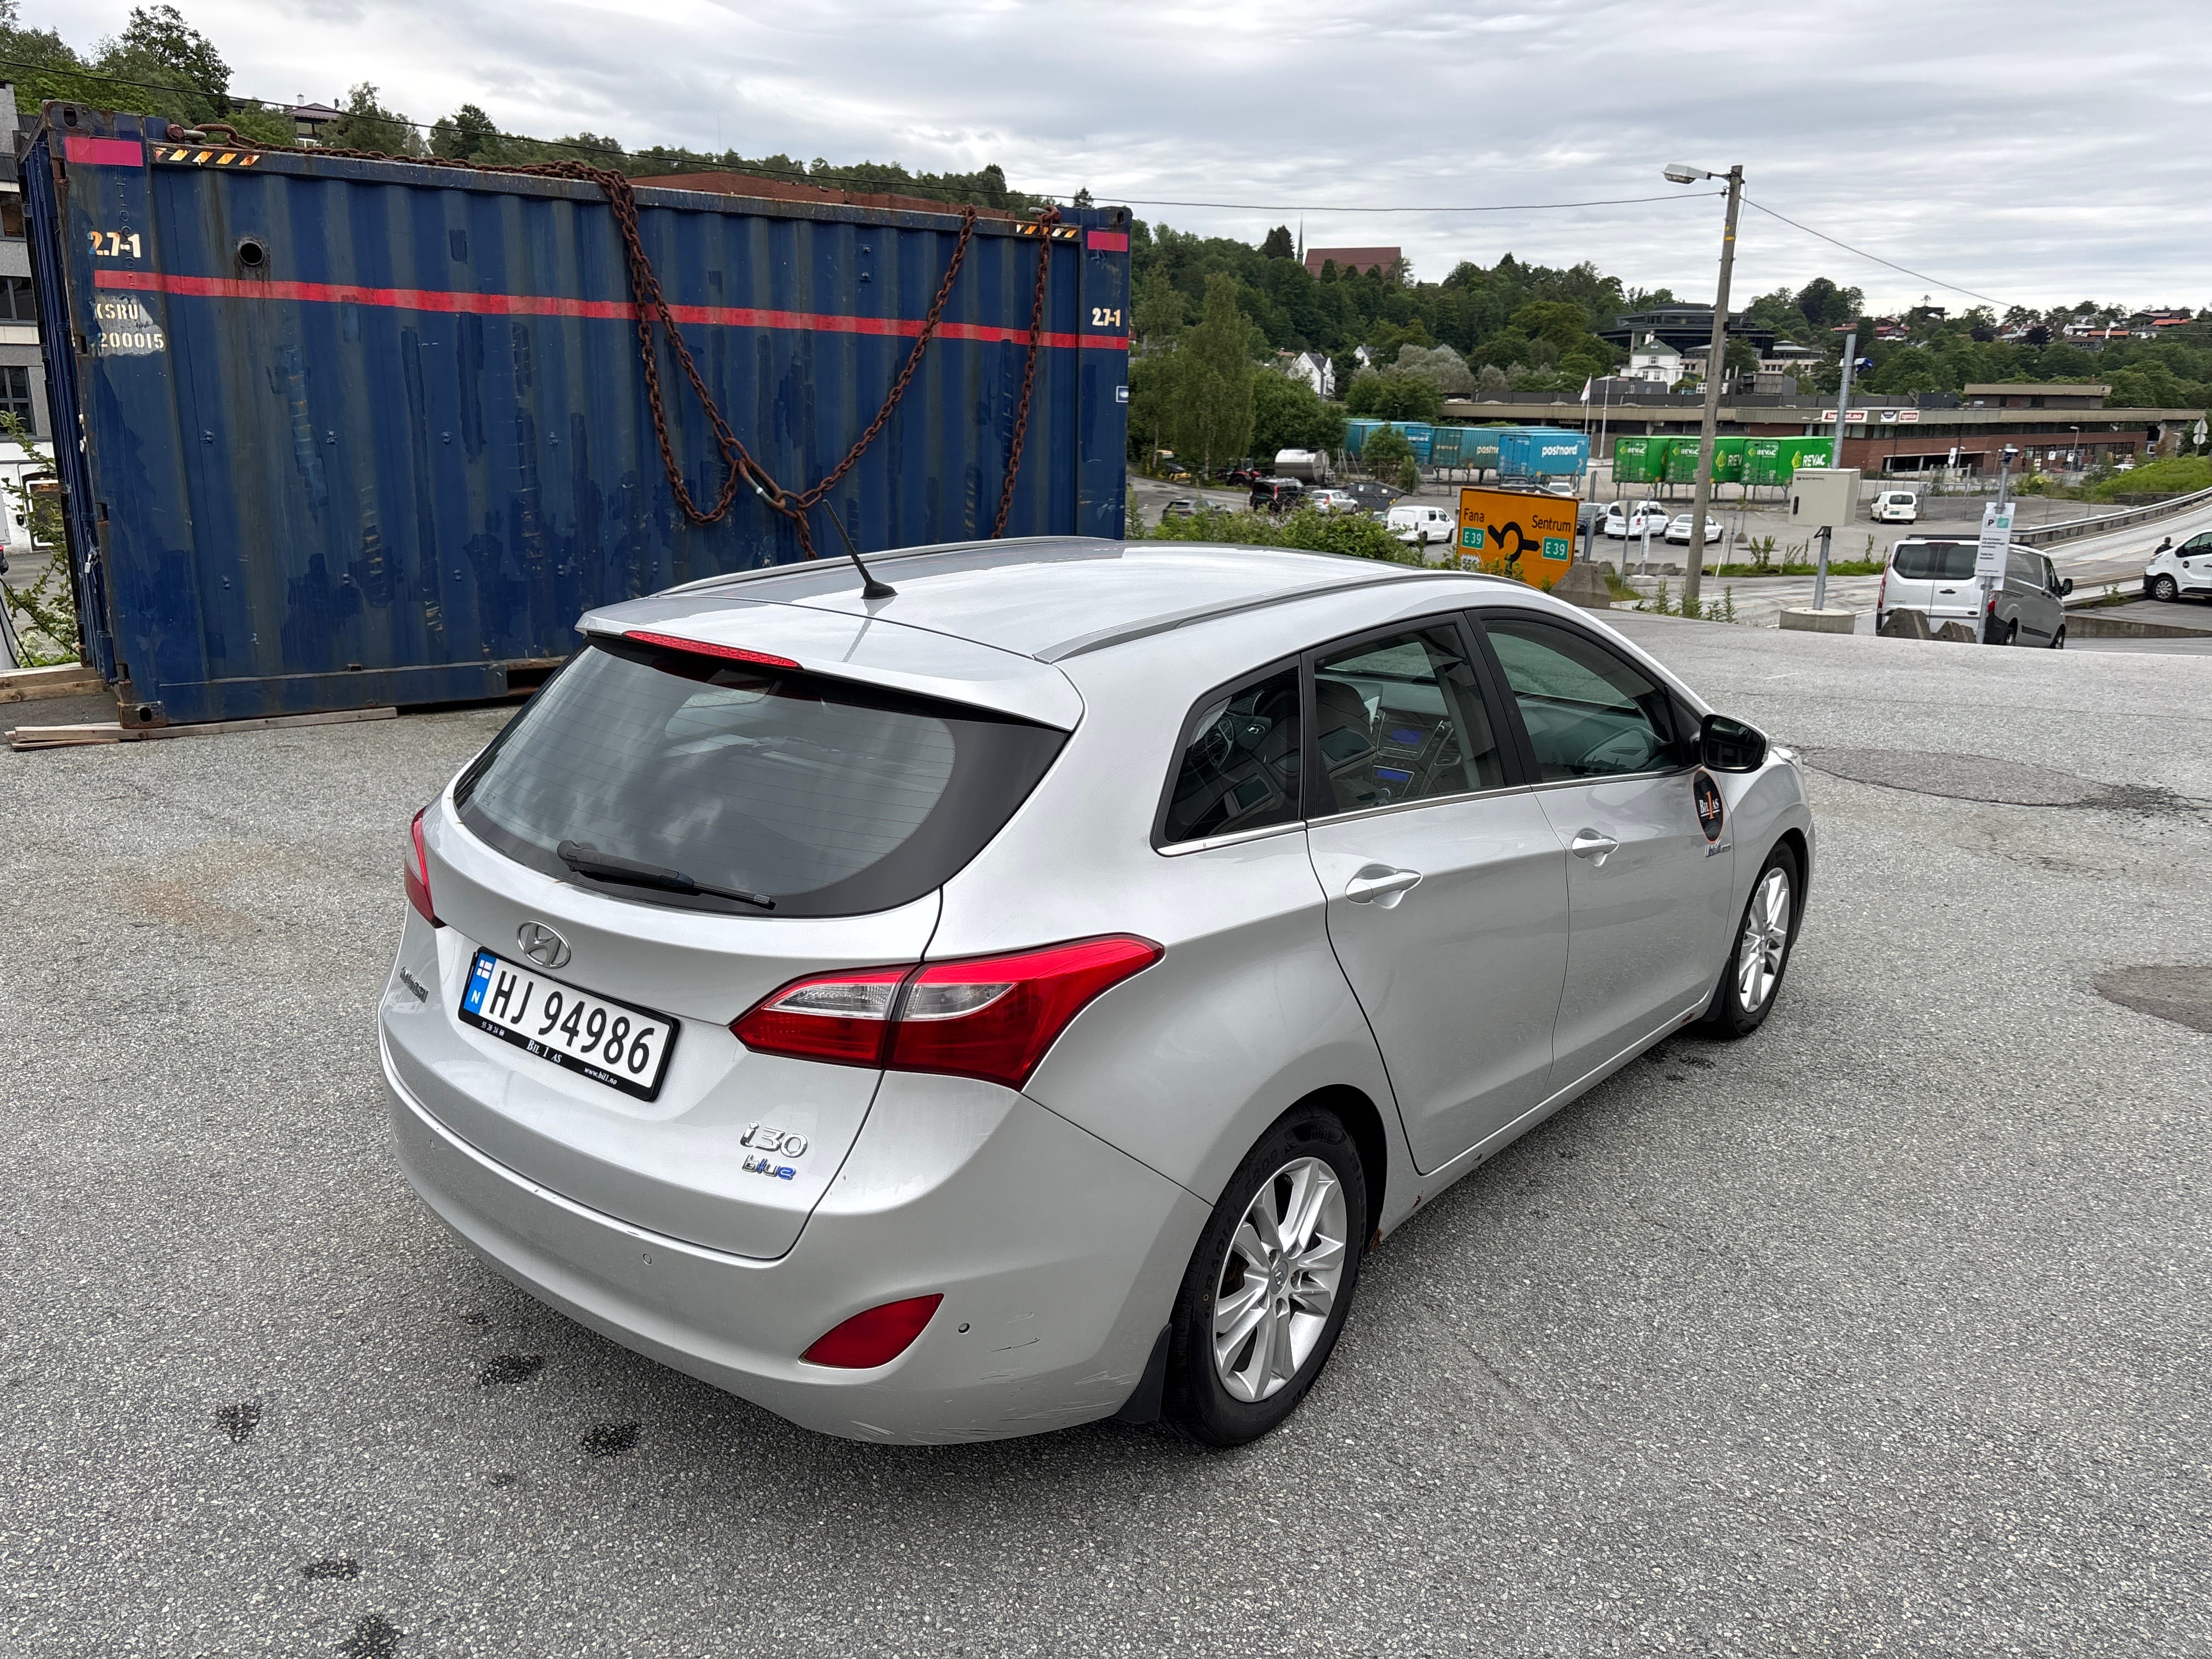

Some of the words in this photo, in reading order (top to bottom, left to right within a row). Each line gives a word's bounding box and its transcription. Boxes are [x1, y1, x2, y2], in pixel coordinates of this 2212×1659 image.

[98, 332, 164, 349] 200015
[1542, 444, 1578, 458] postnord
[1728, 454, 1742, 466] REV
[1803, 454, 1826, 466] REVAC
[1464, 508, 1485, 523] Fana
[1532, 515, 1571, 532] Sentrum
[1464, 532, 1470, 543] E
[1471, 533, 1481, 545] 39
[1545, 541, 1550, 554] E
[1553, 543, 1566, 556] 39
[471, 990, 481, 1004] N
[489, 970, 533, 1024] HJ
[538, 991, 655, 1074] 94986
[551, 1053, 562, 1063] AS
[740, 1121, 808, 1158] i30
[742, 1154, 796, 1180] blue
